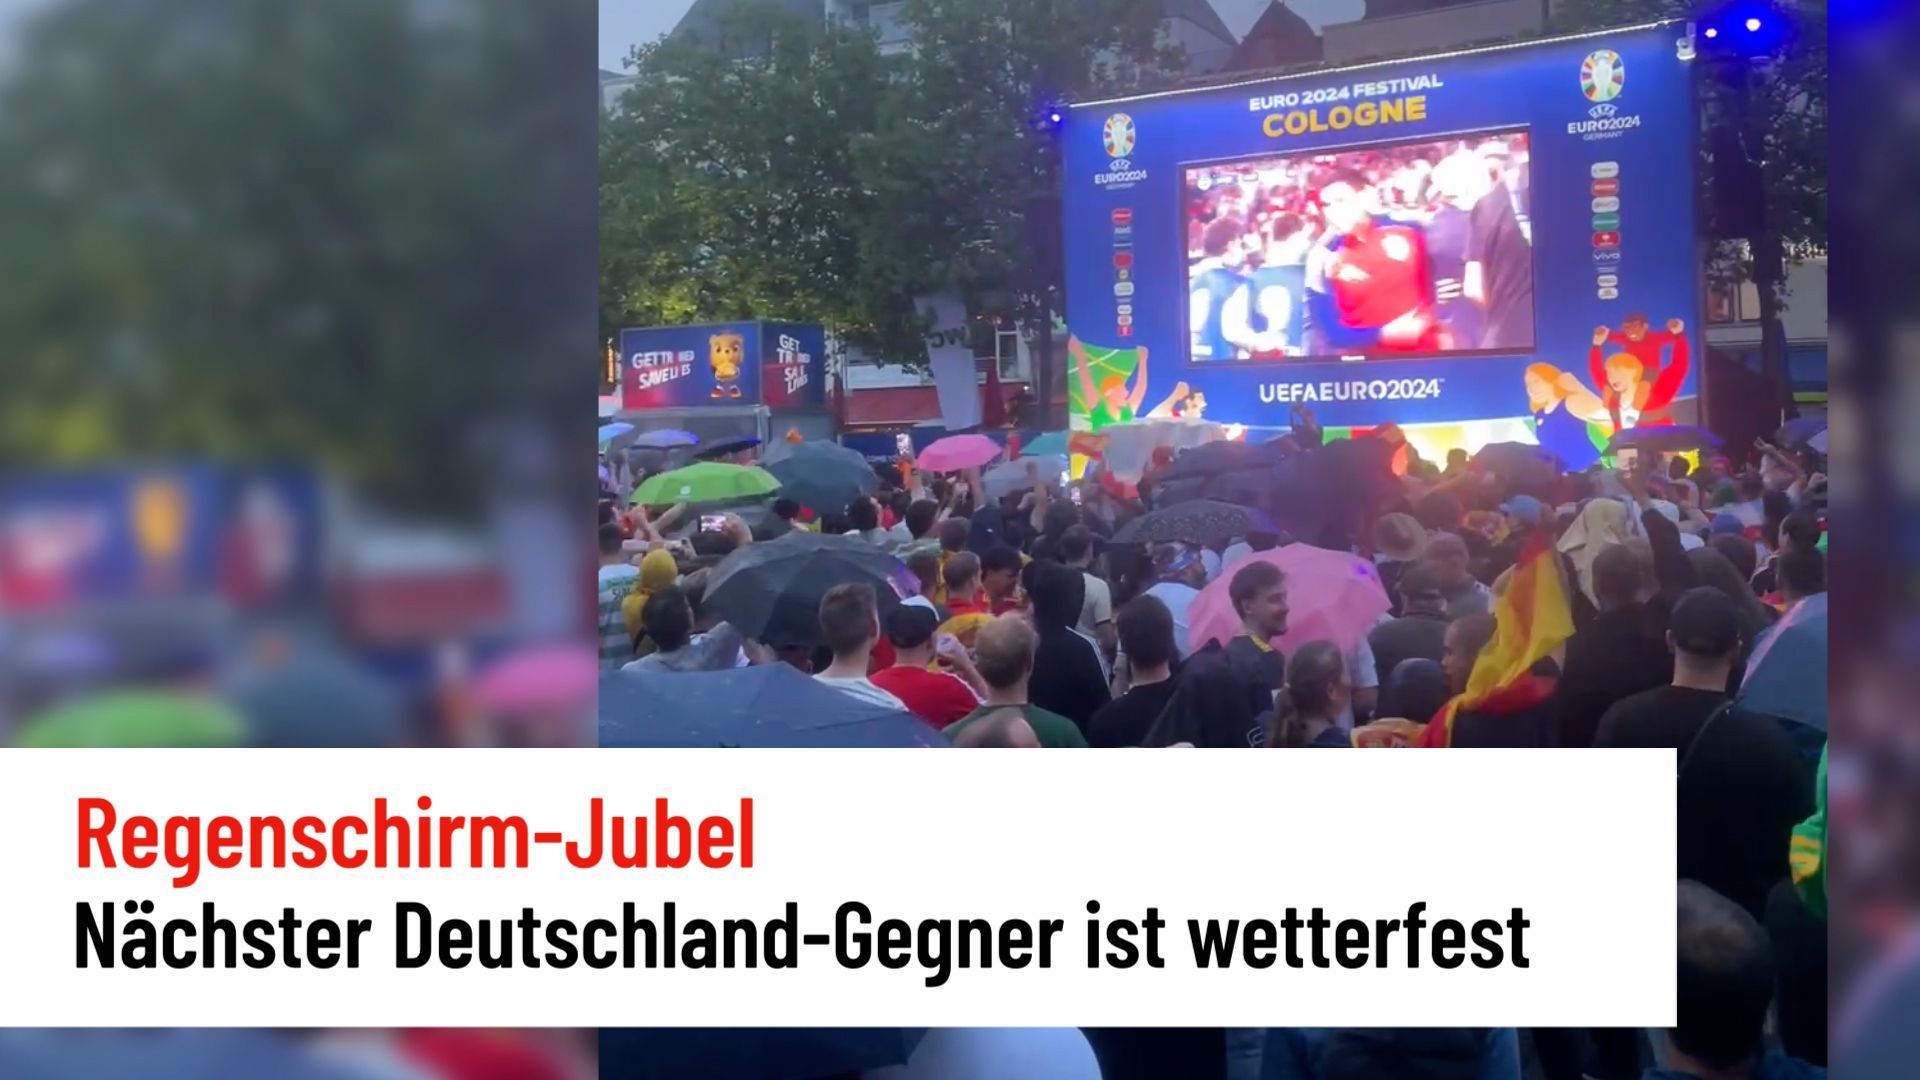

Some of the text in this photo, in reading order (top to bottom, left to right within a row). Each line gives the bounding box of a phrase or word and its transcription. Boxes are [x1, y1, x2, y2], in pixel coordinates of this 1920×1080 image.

[1249, 74, 1444, 112] EURO 2024 FESTIVAL
[1262, 96, 1427, 138] COLOGNE
[778, 334, 800, 353] GET
